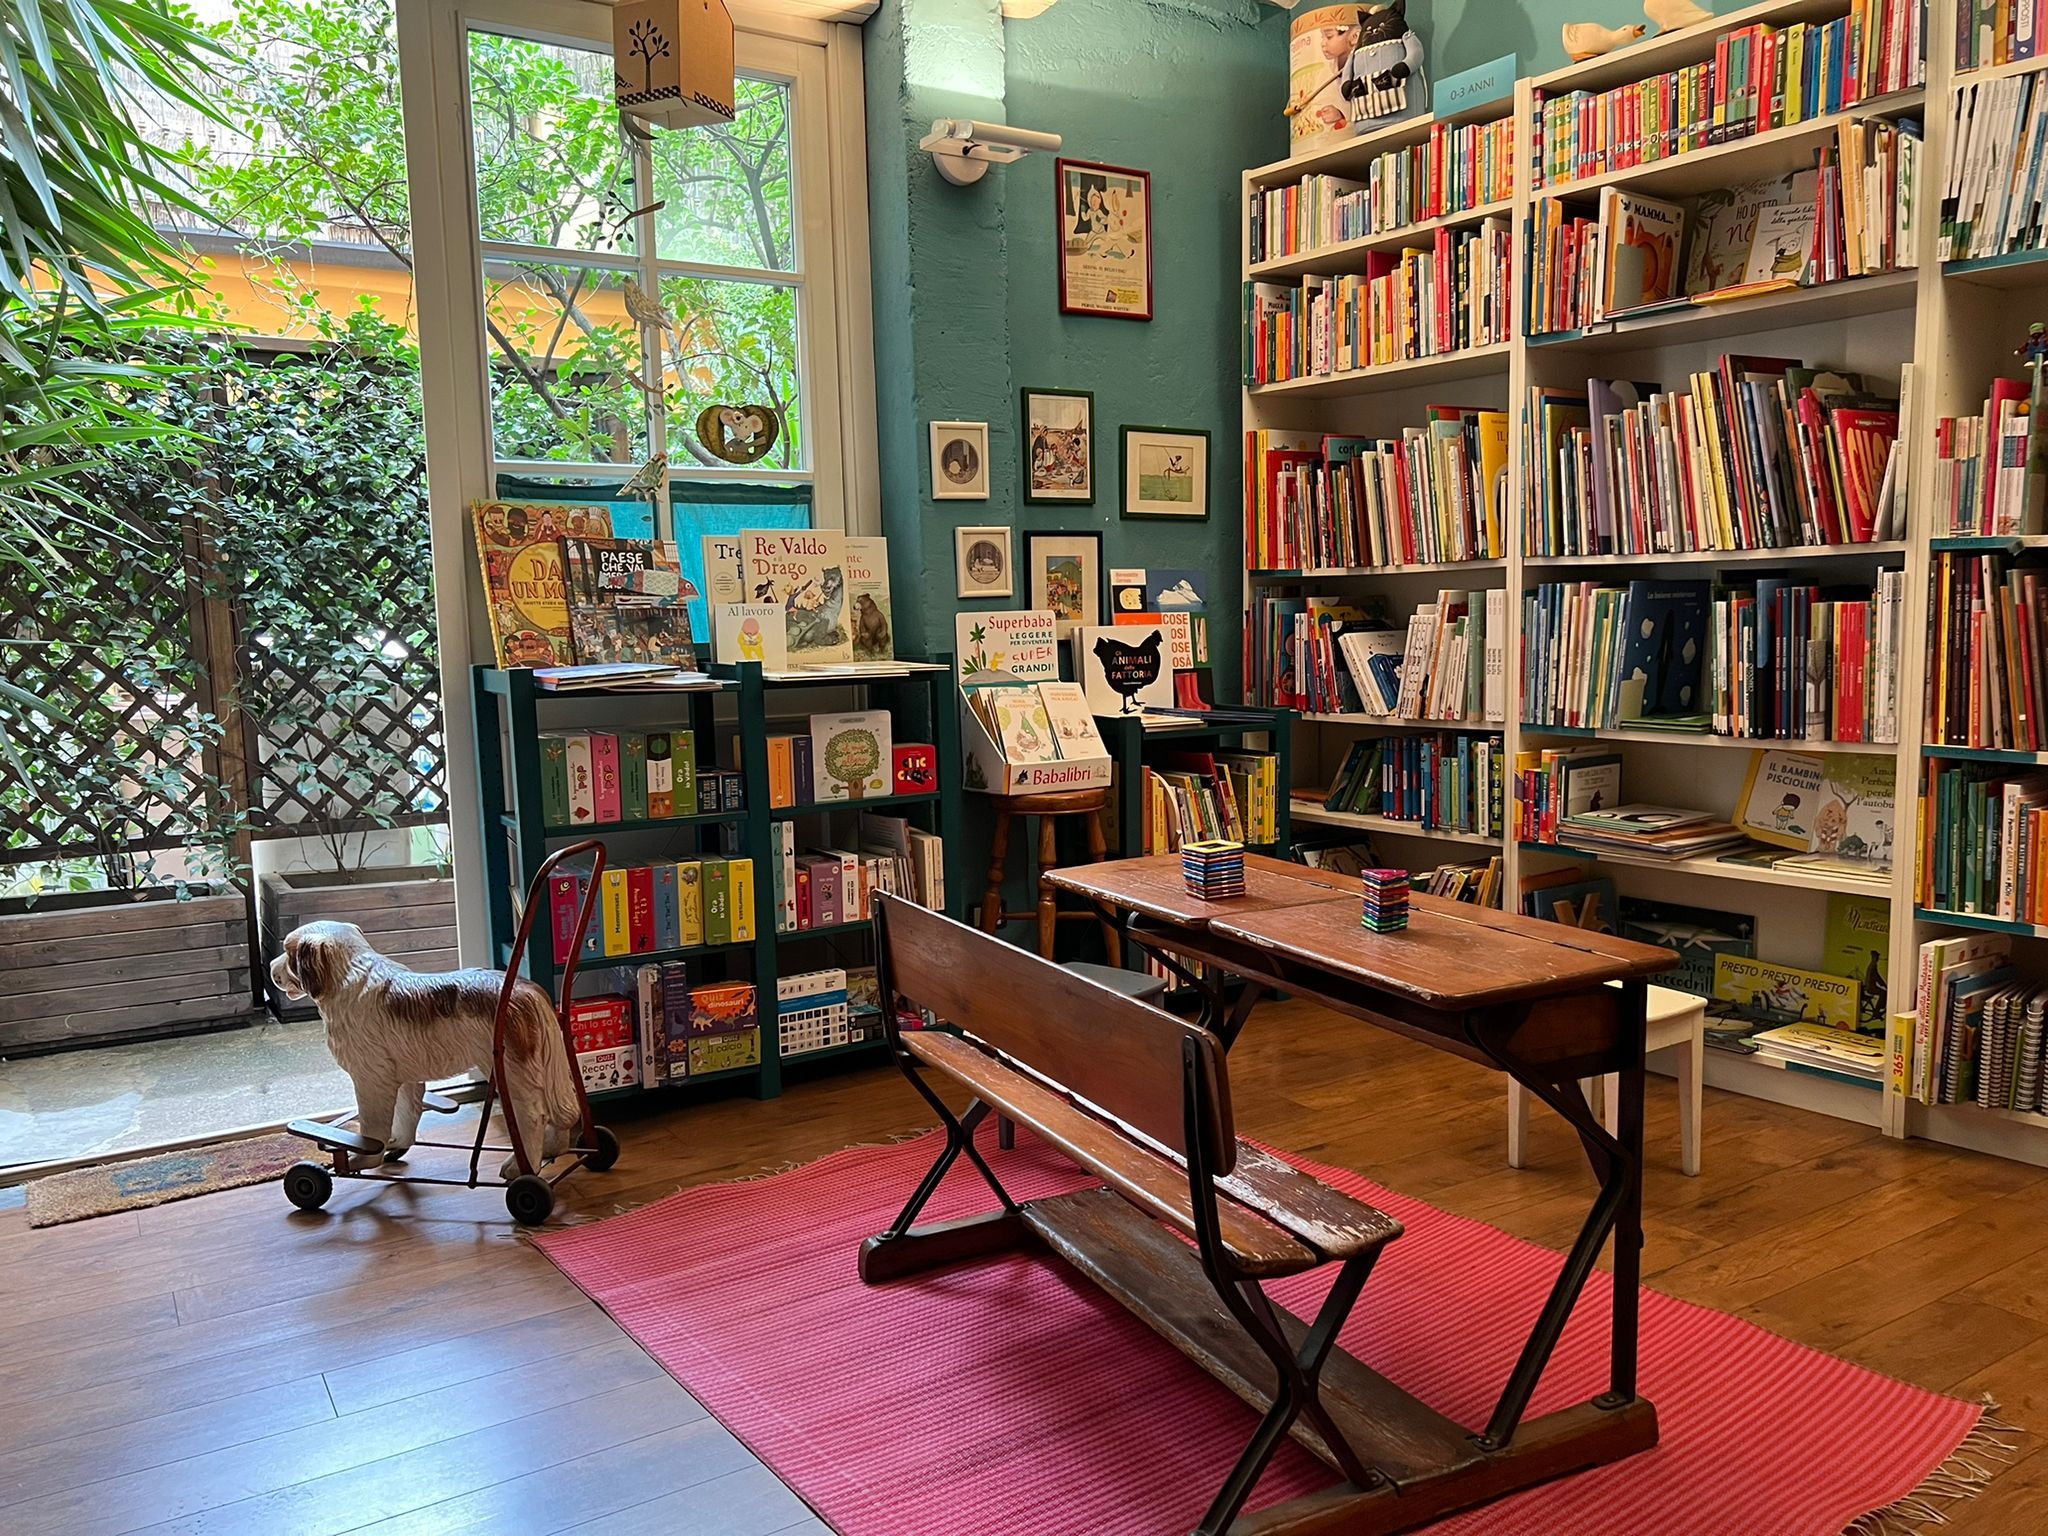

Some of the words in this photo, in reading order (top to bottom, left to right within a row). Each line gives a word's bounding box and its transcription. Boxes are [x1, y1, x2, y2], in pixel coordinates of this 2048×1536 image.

[1450, 86, 1467, 101] 0-3
[1468, 76, 1495, 95] ANNI
[1634, 204, 1674, 225] MAMMA...
[1736, 206, 1749, 219] HO
[714, 544, 742, 559] Tre
[754, 537, 776, 556] Re
[780, 537, 827, 555] Valdo
[601, 552, 644, 564] PAESE
[601, 562, 623, 572] CHE
[752, 559, 807, 581] Drago
[512, 582, 540, 599] UN
[728, 606, 740, 617] Al
[742, 606, 774, 617] lavoro
[988, 615, 1053, 632] Superbaba
[1163, 613, 1189, 625] COSE
[1009, 631, 1053, 640] LEGGERE
[1012, 647, 1053, 662] SUPER
[1112, 655, 1152, 665] ANIMALI
[1011, 663, 1054, 673] GRANDI!
[1111, 670, 1152, 679] FATTORIA
[1769, 762, 1778, 771] IL
[1033, 766, 1091, 785] Babalibri
[1866, 789, 1893, 798] perde
[1720, 960, 1759, 977] PRESTO
[1761, 969, 1801, 986] PRESTO
[1803, 977, 1850, 996] PRESTO!
[701, 993, 725, 1003] QUIZ
[571, 1022, 587, 1031] Chi
[722, 1034, 740, 1042] QUIZ
[597, 1053, 614, 1062] QUIZ
[582, 1061, 616, 1074] Record
[1893, 1053, 1904, 1077] 365
